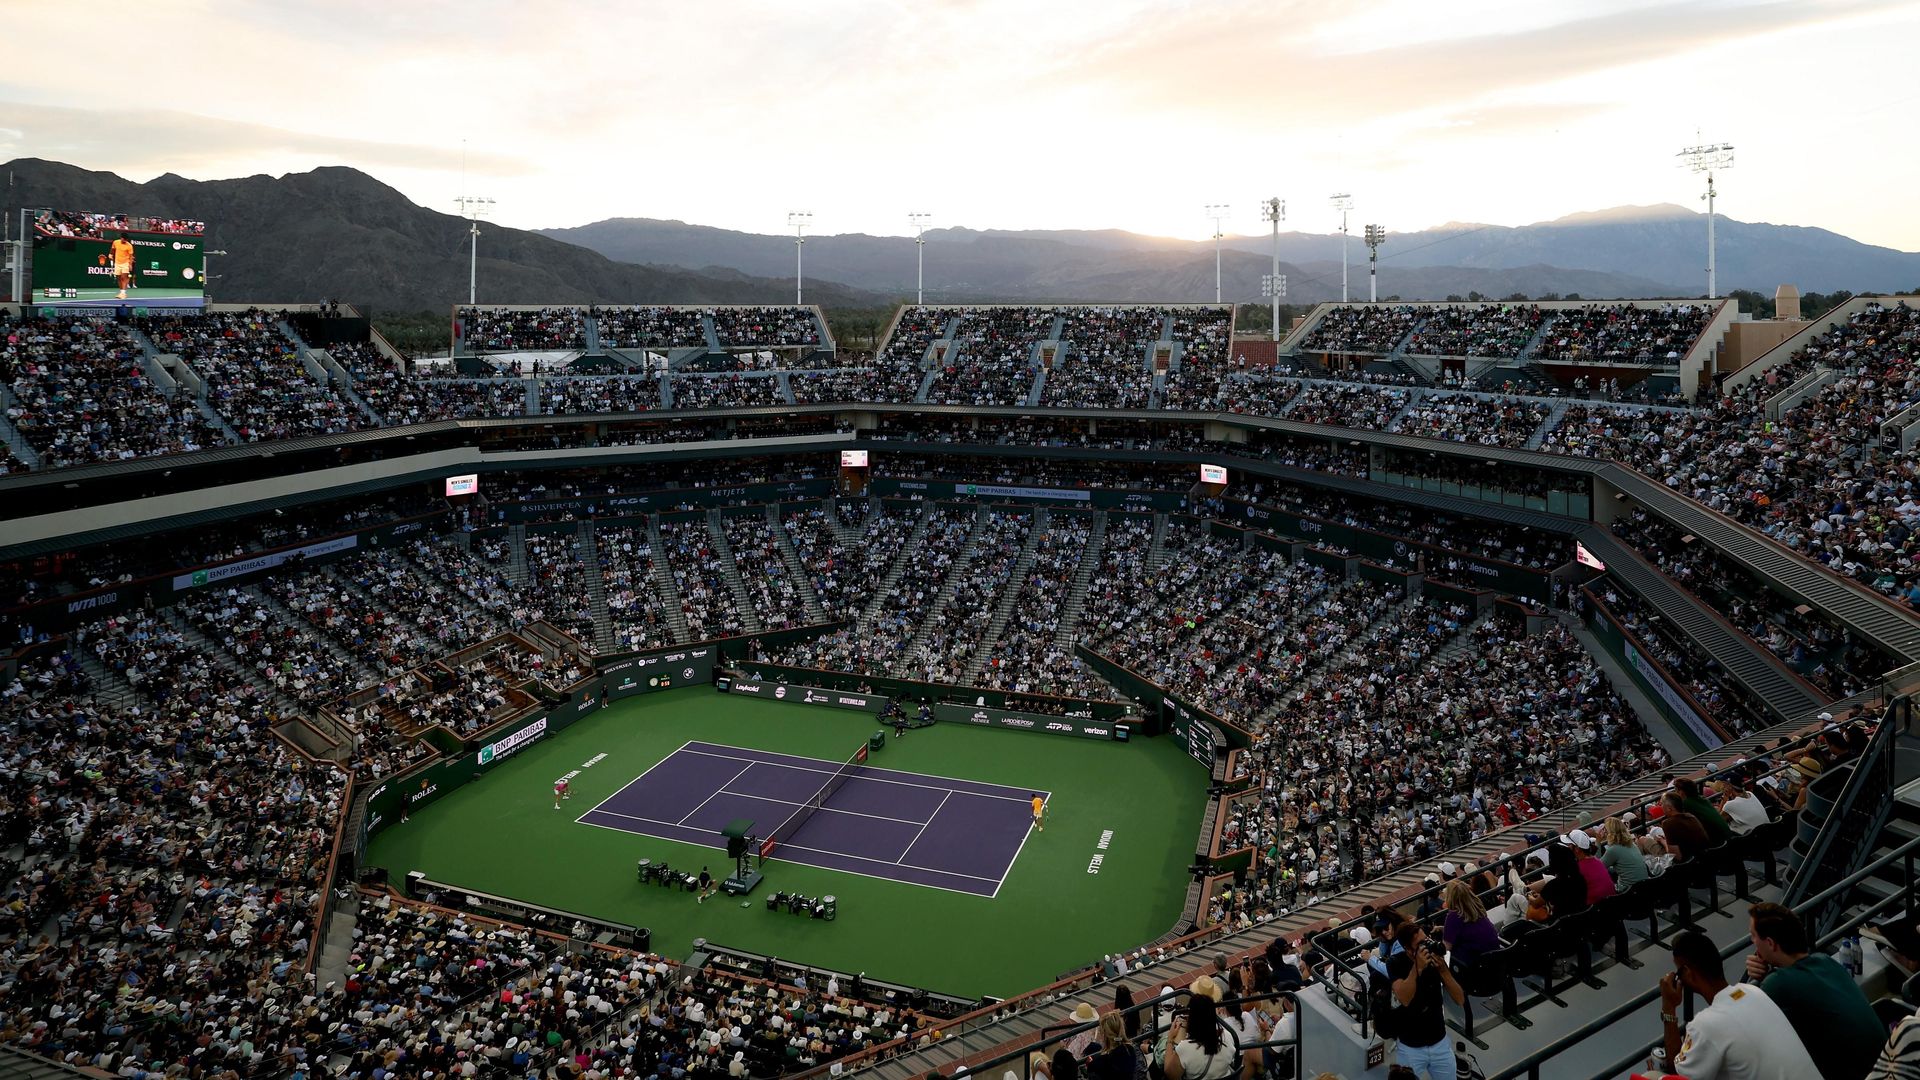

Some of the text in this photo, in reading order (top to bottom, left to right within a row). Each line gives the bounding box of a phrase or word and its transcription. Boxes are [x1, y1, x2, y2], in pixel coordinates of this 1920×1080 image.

[58, 307, 113, 316] BNP PARIBAS
[711, 488, 745, 496] NETJETS
[527, 502, 581, 512] SILVERSEA
[1309, 522, 1322, 533] PIF
[210, 559, 266, 579] BNP PARIBAS
[68, 593, 117, 613] WTA 1000
[735, 684, 760, 692] Laykold
[578, 698, 595, 711] ROLEX
[1046, 722, 1062, 730] ATP
[1084, 727, 1108, 735] verizon
[495, 720, 544, 753] BNP PARIBAS
[412, 784, 437, 802] ROLEX
[1087, 829, 1114, 875] INDIAN WELLS
[1369, 1053, 1382, 1064] 423
